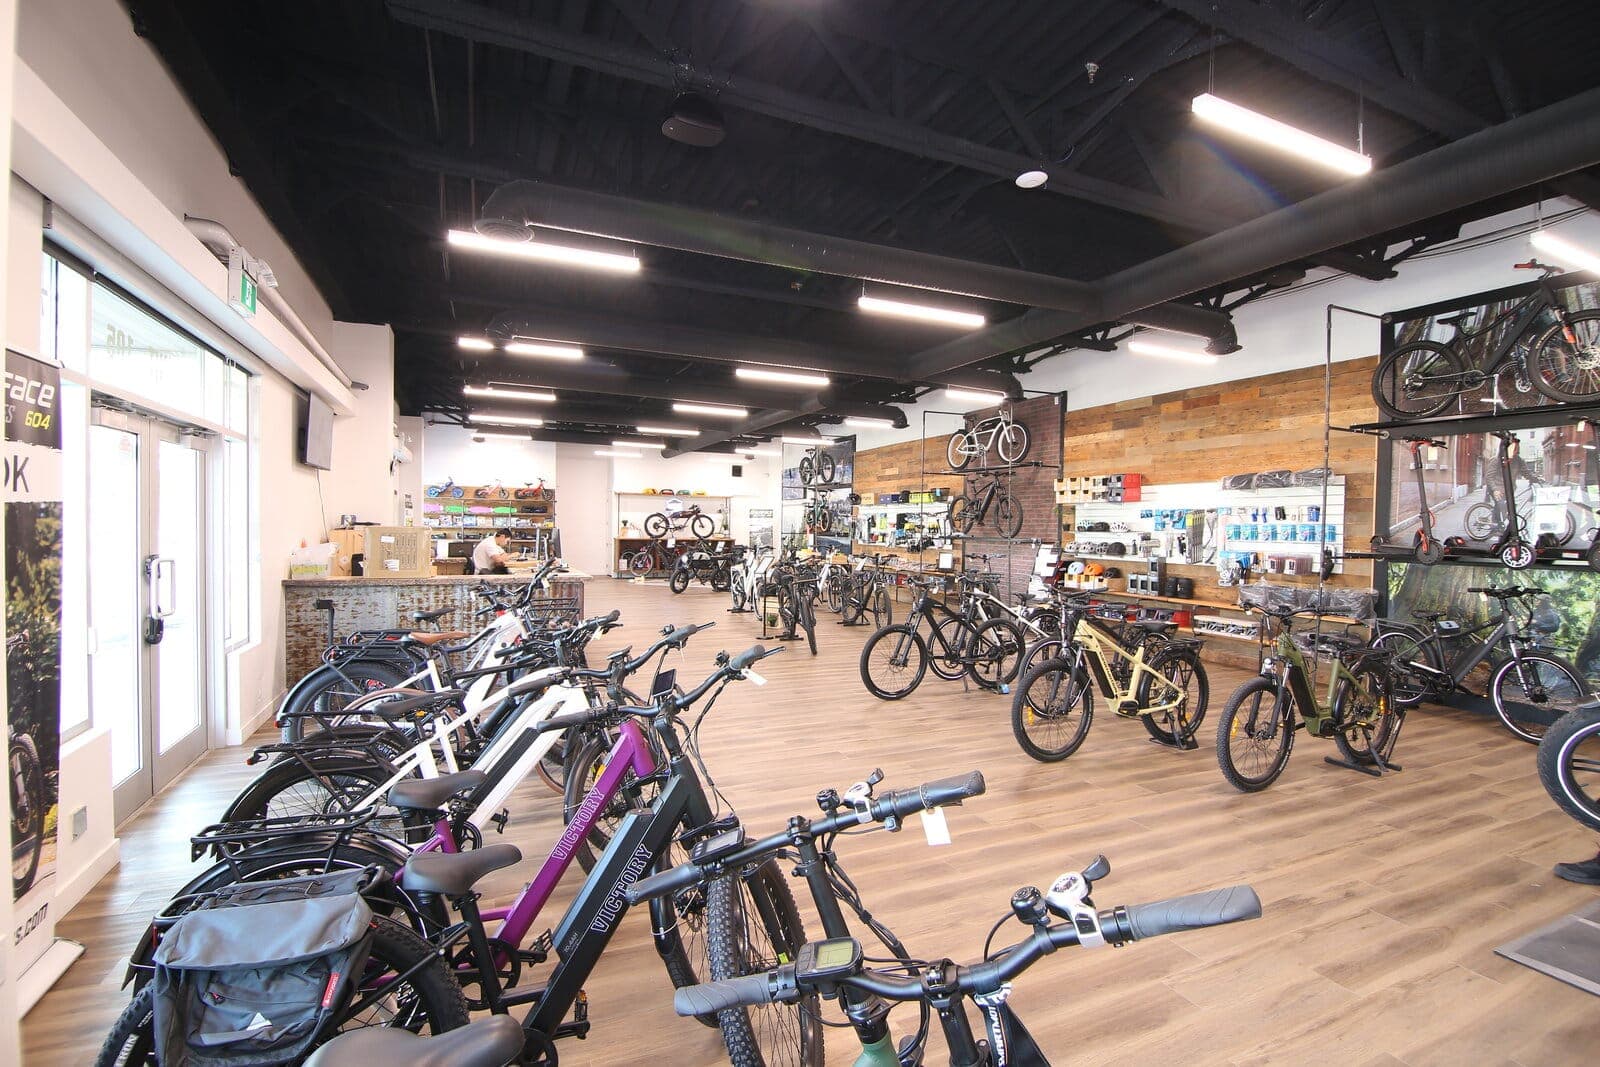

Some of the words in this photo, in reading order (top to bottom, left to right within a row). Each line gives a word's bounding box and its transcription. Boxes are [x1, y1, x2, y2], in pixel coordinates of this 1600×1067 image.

[24, 410, 51, 430] 604
[552, 787, 605, 860] VICTORY
[591, 843, 653, 933] VICTORY
